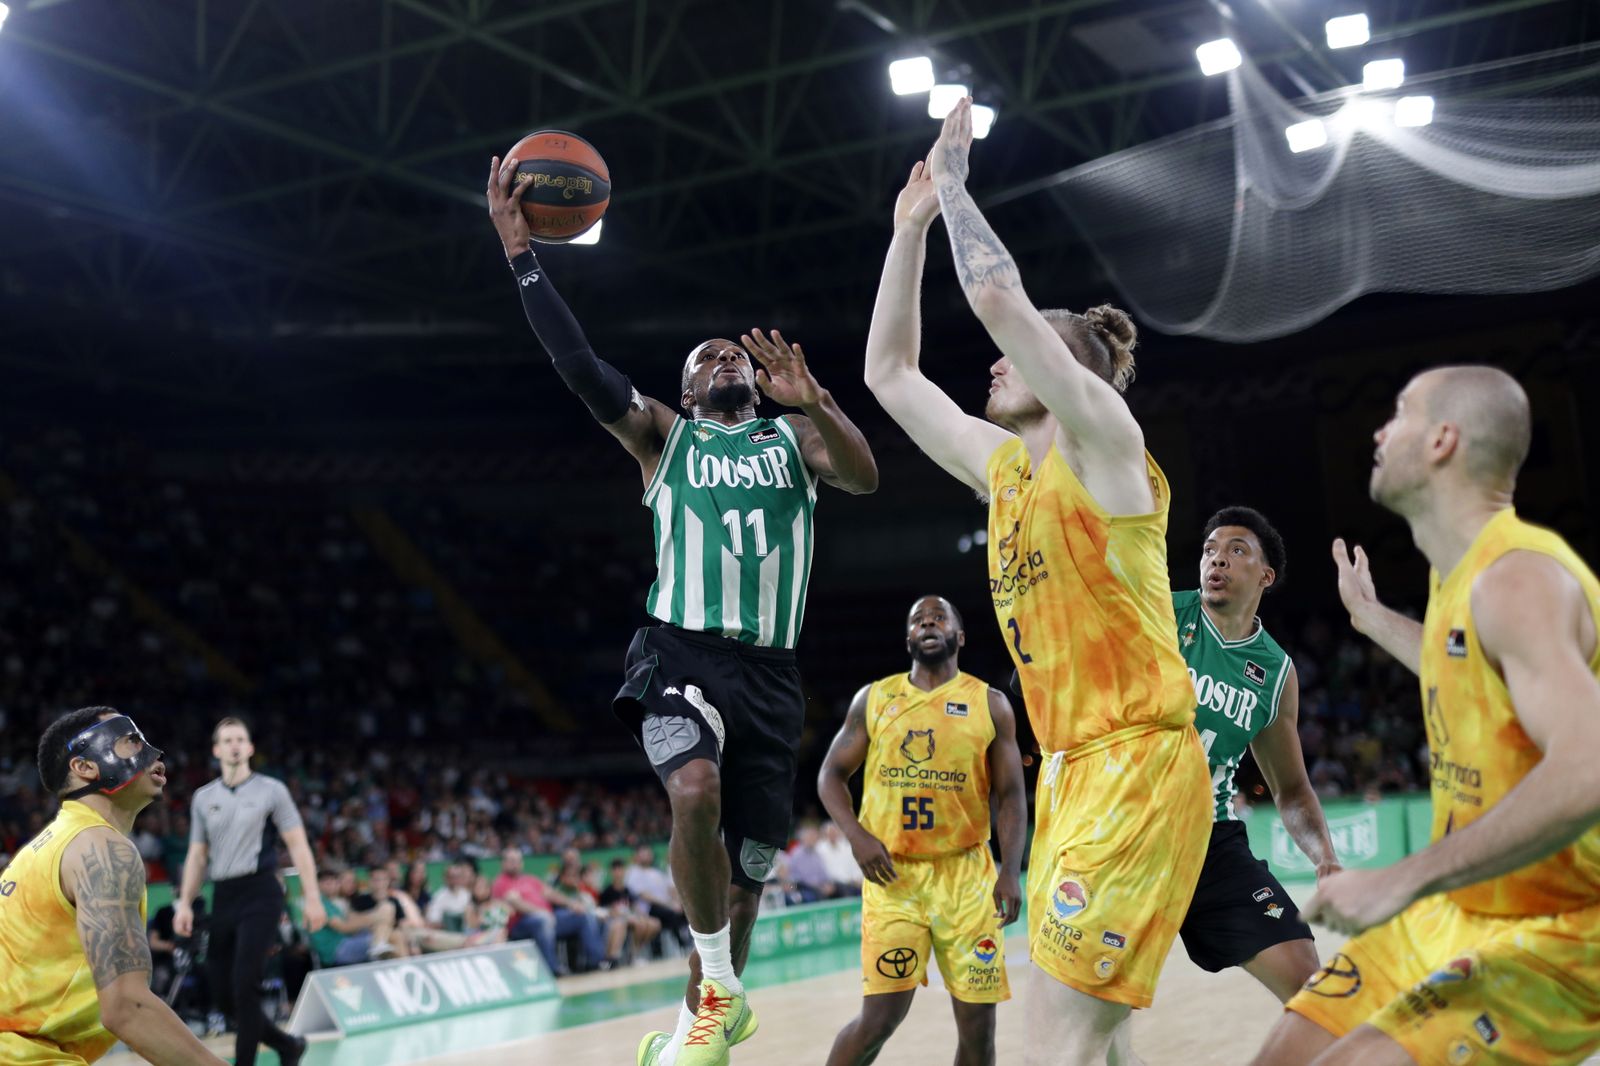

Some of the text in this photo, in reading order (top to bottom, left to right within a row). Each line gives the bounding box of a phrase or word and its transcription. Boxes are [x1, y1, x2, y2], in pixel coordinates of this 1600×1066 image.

[686, 445, 794, 489] COOSUR
[722, 508, 768, 556] 11
[903, 797, 935, 830] 55
[1104, 937, 1120, 948] acb
[430, 957, 511, 1007] WAR
